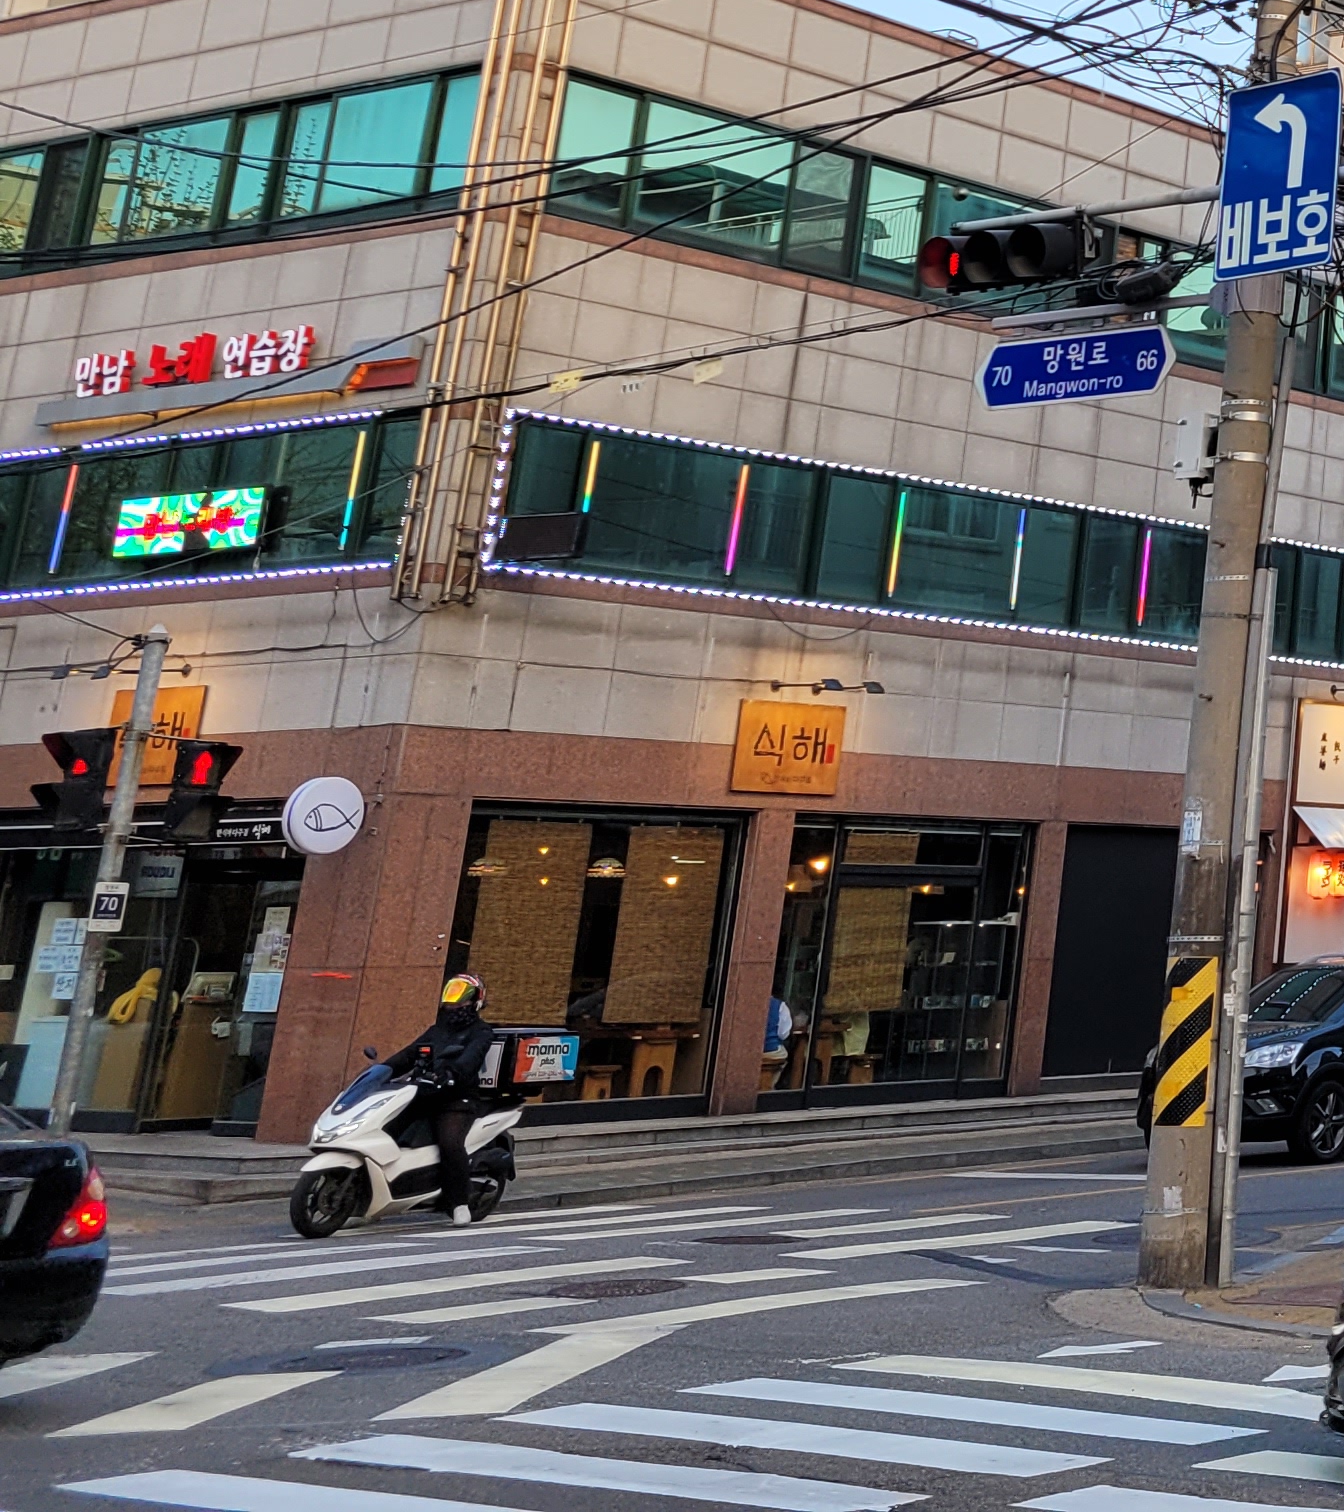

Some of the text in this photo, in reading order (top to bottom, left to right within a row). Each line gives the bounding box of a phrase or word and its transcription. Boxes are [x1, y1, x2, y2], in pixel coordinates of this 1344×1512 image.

[1218, 189, 1331, 269] 비보호
[75, 324, 316, 398] 만남 노래 연습장
[1042, 340, 1110, 374] 망원로
[1136, 349, 1159, 372] 66
[991, 365, 1012, 387] 70
[1023, 374, 1124, 398] Mangwon-ro
[99, 896, 119, 911] 70
[527, 1044, 570, 1056] manna
